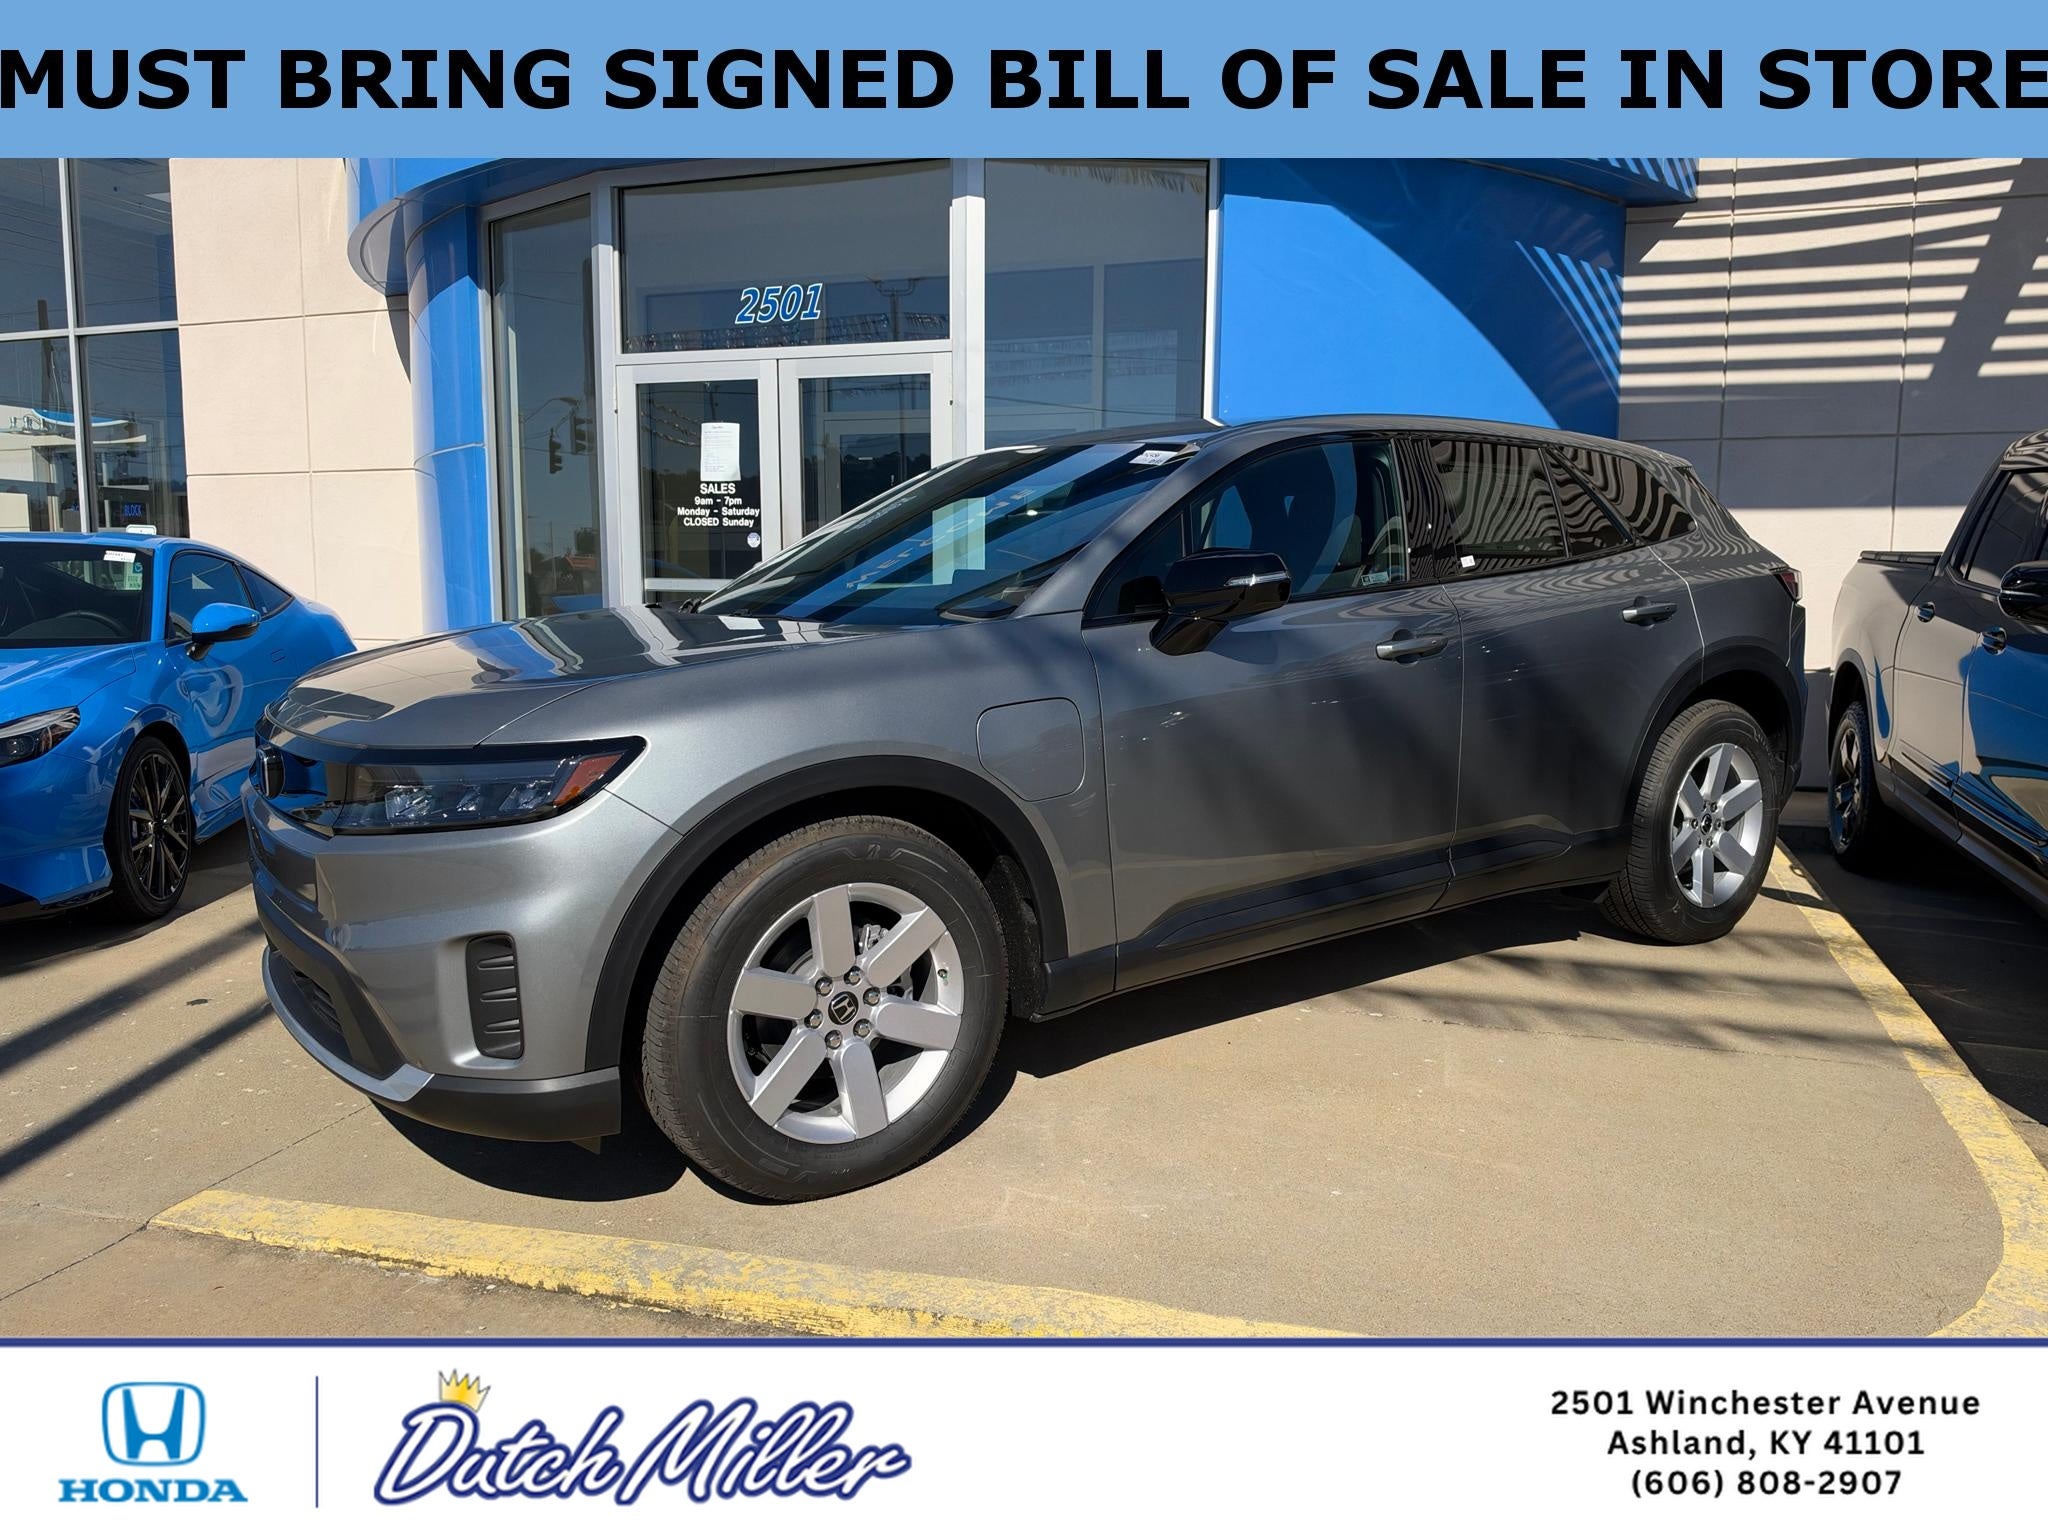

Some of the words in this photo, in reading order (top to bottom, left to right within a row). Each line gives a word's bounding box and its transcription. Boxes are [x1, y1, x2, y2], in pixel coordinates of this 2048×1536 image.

[735, 283, 823, 325] 2501
[700, 483, 736, 494] SALES
[694, 496, 713, 505] 9am
[724, 496, 742, 506] 7pm
[677, 507, 710, 517] Monday
[722, 507, 760, 517] Saturday
[683, 517, 719, 526] CLOSED
[722, 517, 754, 527] Sunday
